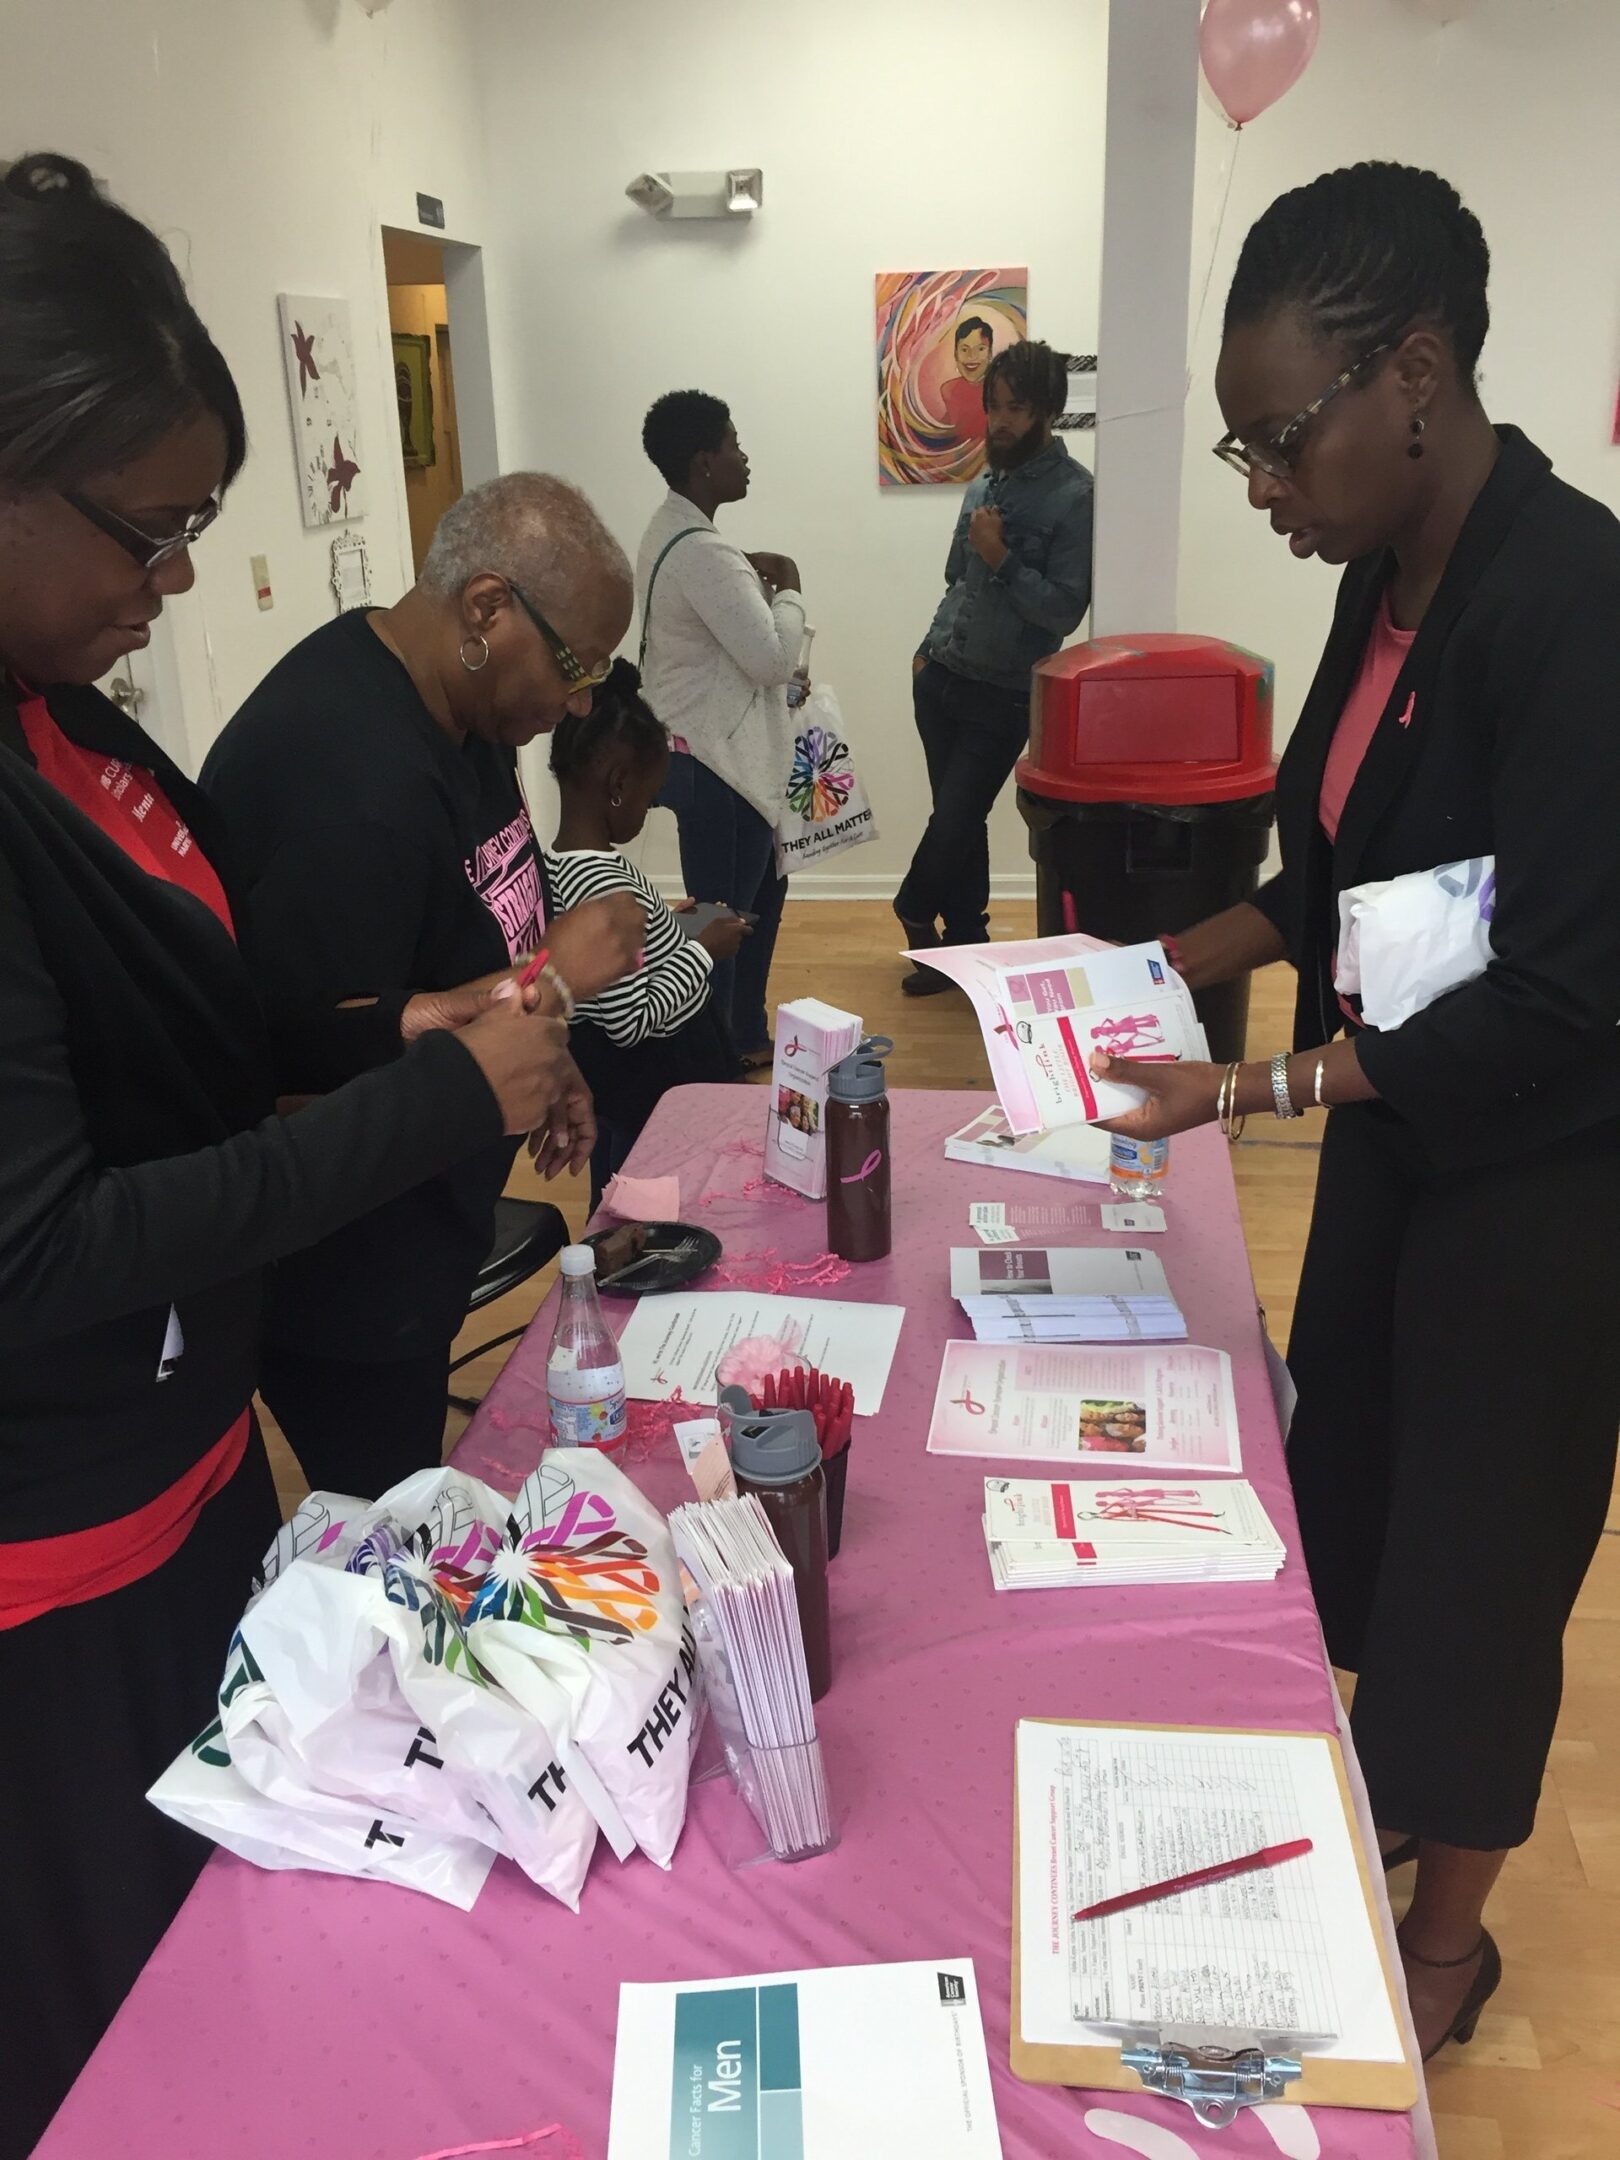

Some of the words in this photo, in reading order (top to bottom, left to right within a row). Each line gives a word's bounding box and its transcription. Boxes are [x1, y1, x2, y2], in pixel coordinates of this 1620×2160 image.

[781, 835, 812, 854] THEY
[813, 828, 834, 843] ALL
[627, 1667, 687, 1768] THEY
[690, 2064, 703, 2081] for
[708, 2040, 742, 2112] Men
[690, 2082, 703, 2113] Facts
[689, 2116, 702, 2157] Cancer
